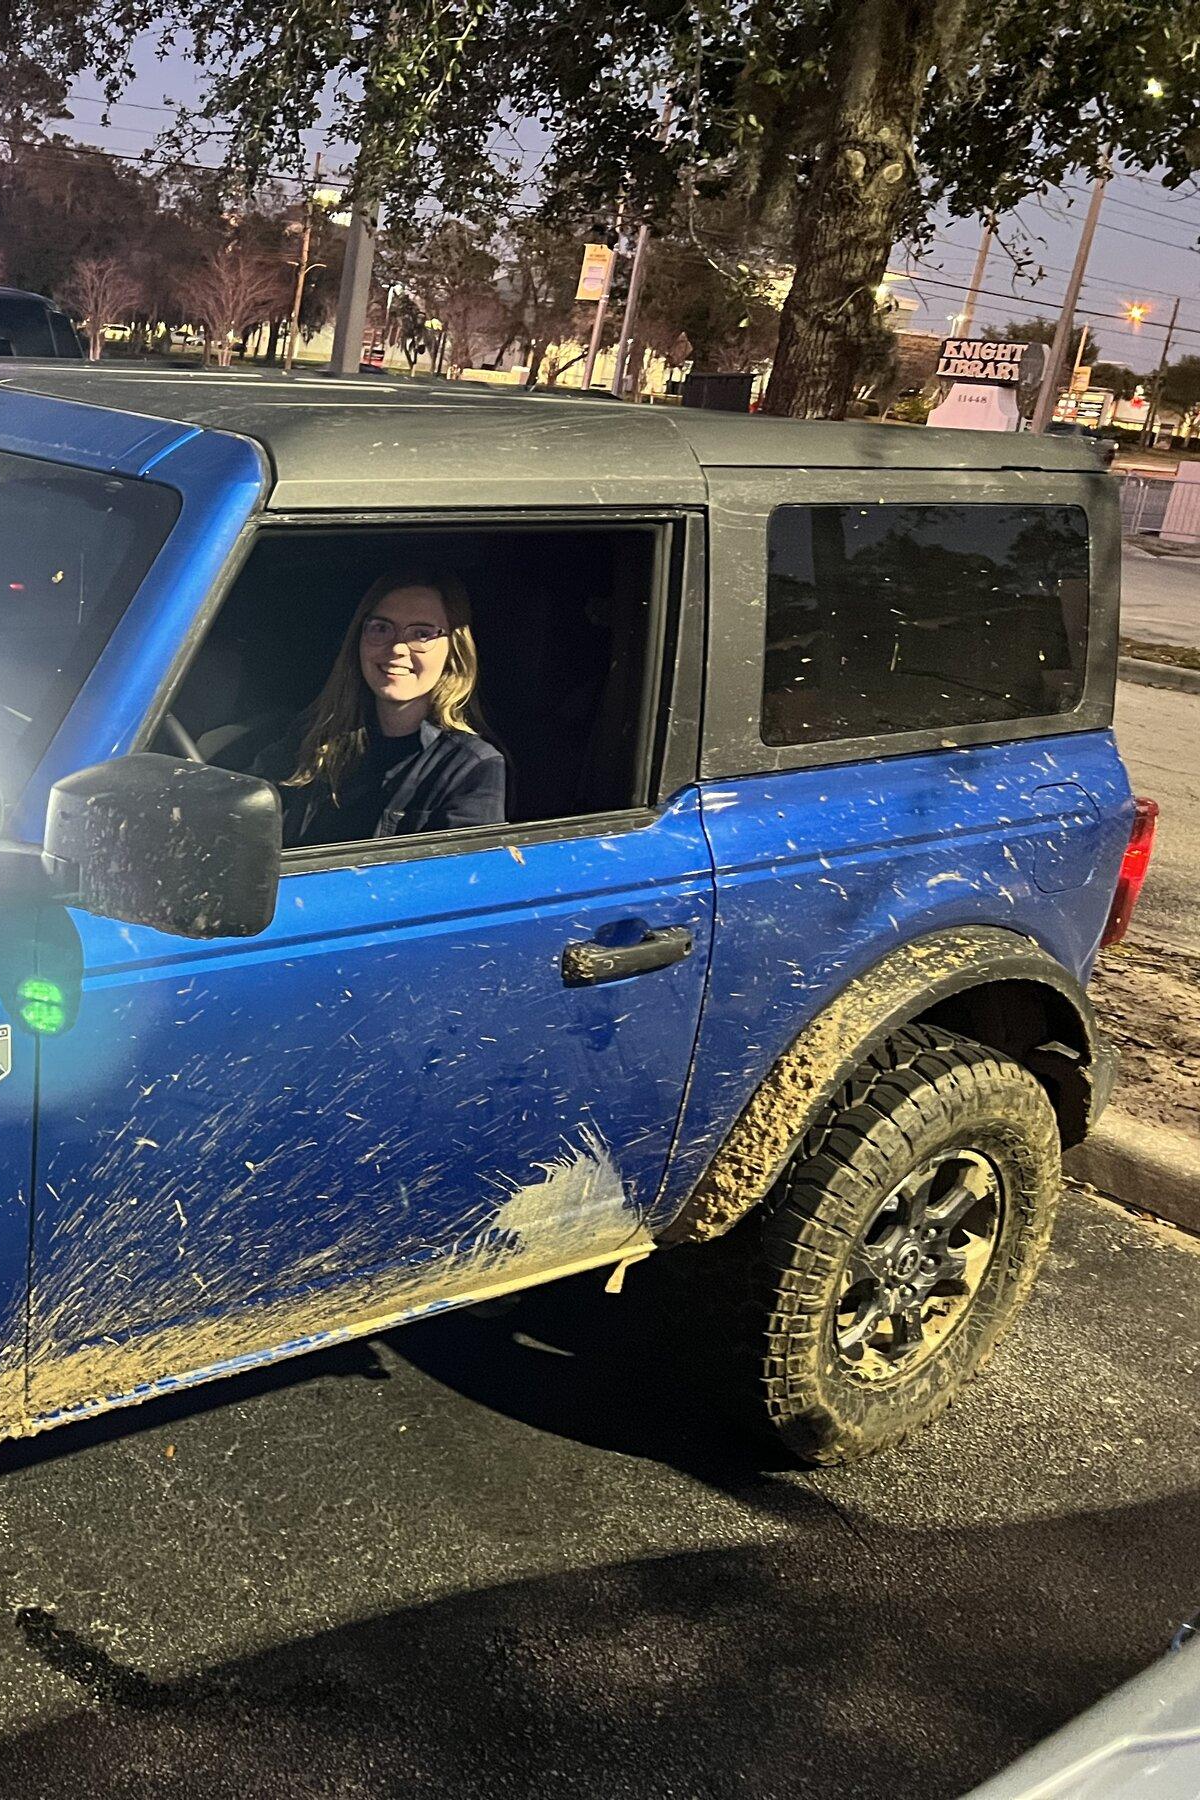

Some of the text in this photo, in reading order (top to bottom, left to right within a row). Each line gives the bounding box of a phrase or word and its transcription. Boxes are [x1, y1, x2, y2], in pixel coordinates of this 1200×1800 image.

[943, 340, 1029, 361] KNIGHT
[936, 358, 1019, 381] LIBRARY
[958, 394, 988, 404] 11448
